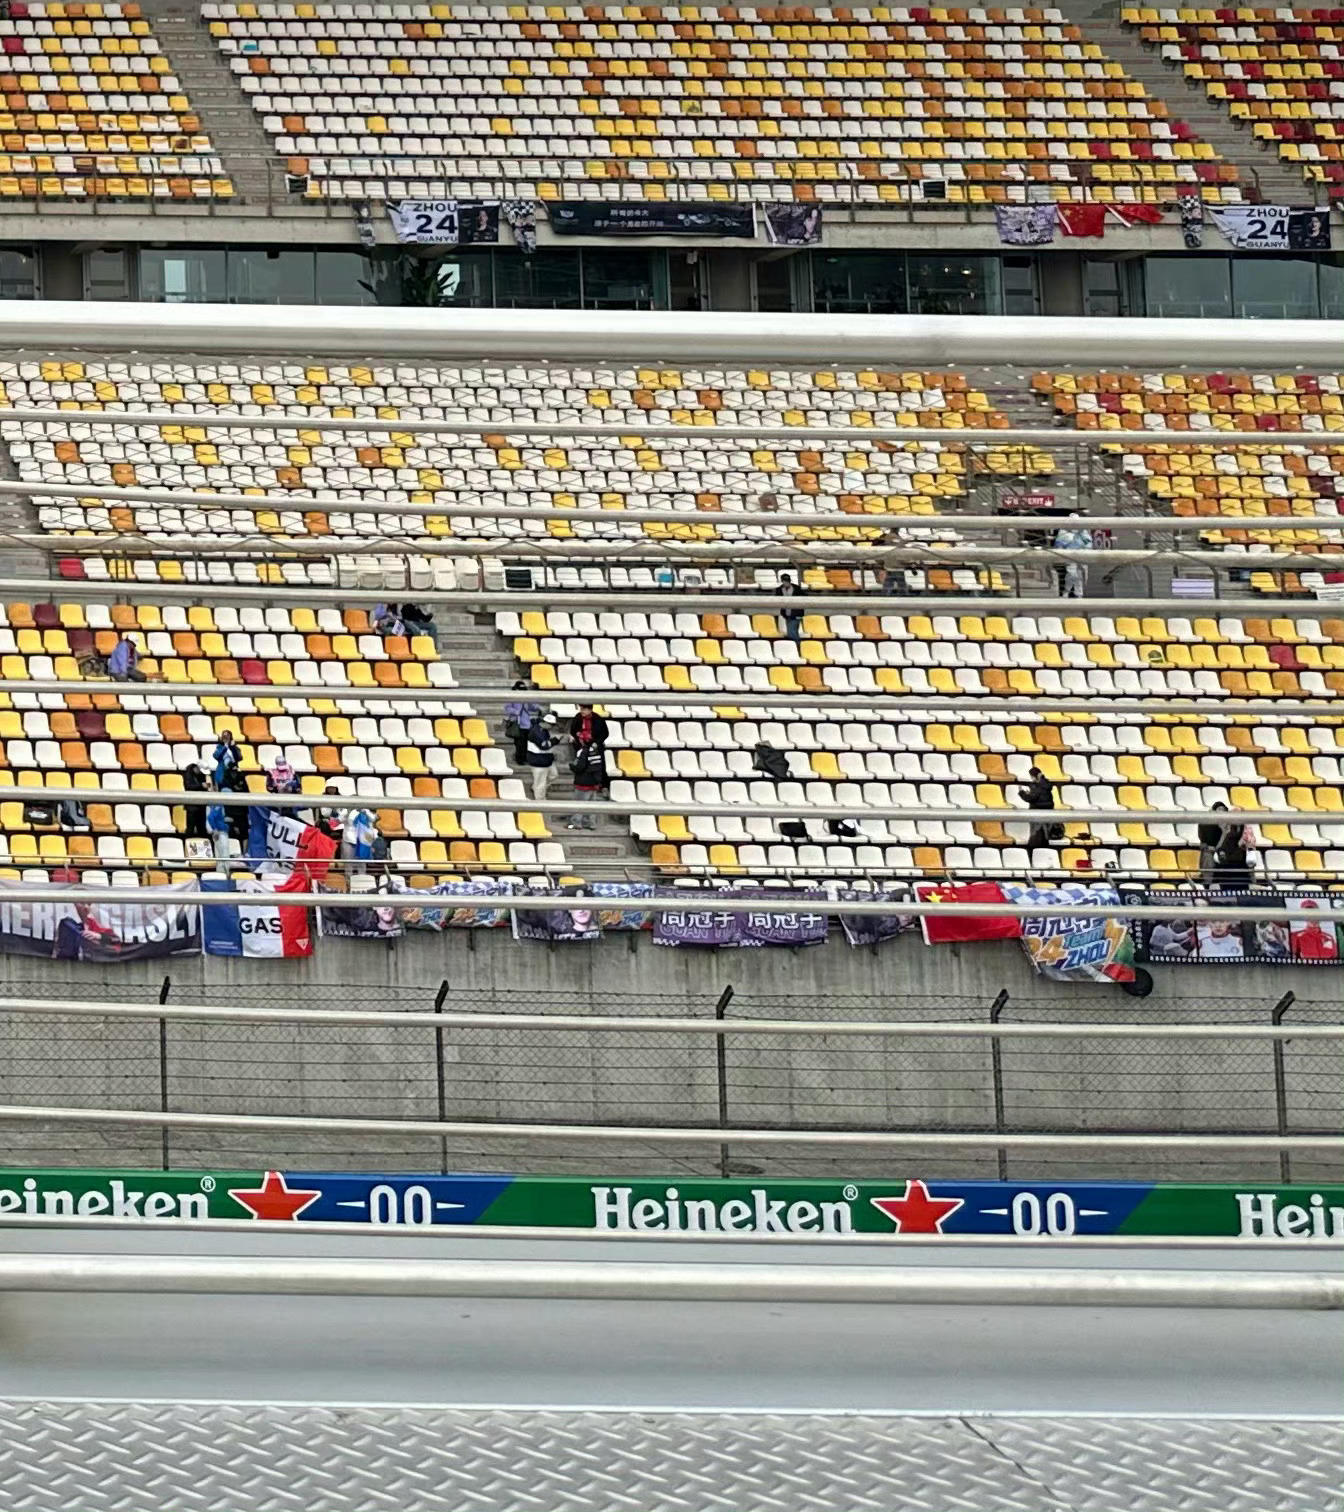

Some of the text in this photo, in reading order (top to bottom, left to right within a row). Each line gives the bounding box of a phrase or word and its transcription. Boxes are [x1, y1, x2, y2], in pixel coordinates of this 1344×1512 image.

[413, 202, 458, 212] ZHOU
[1246, 208, 1290, 218] ZHOU
[415, 214, 458, 234] 24
[1247, 219, 1288, 240] 24
[416, 235, 459, 243] GUANYU
[1246, 241, 1290, 249] GUANYU
[267, 816, 309, 850] ULL
[239, 917, 283, 934] GAS
[591, 1186, 857, 1234] Heineken
